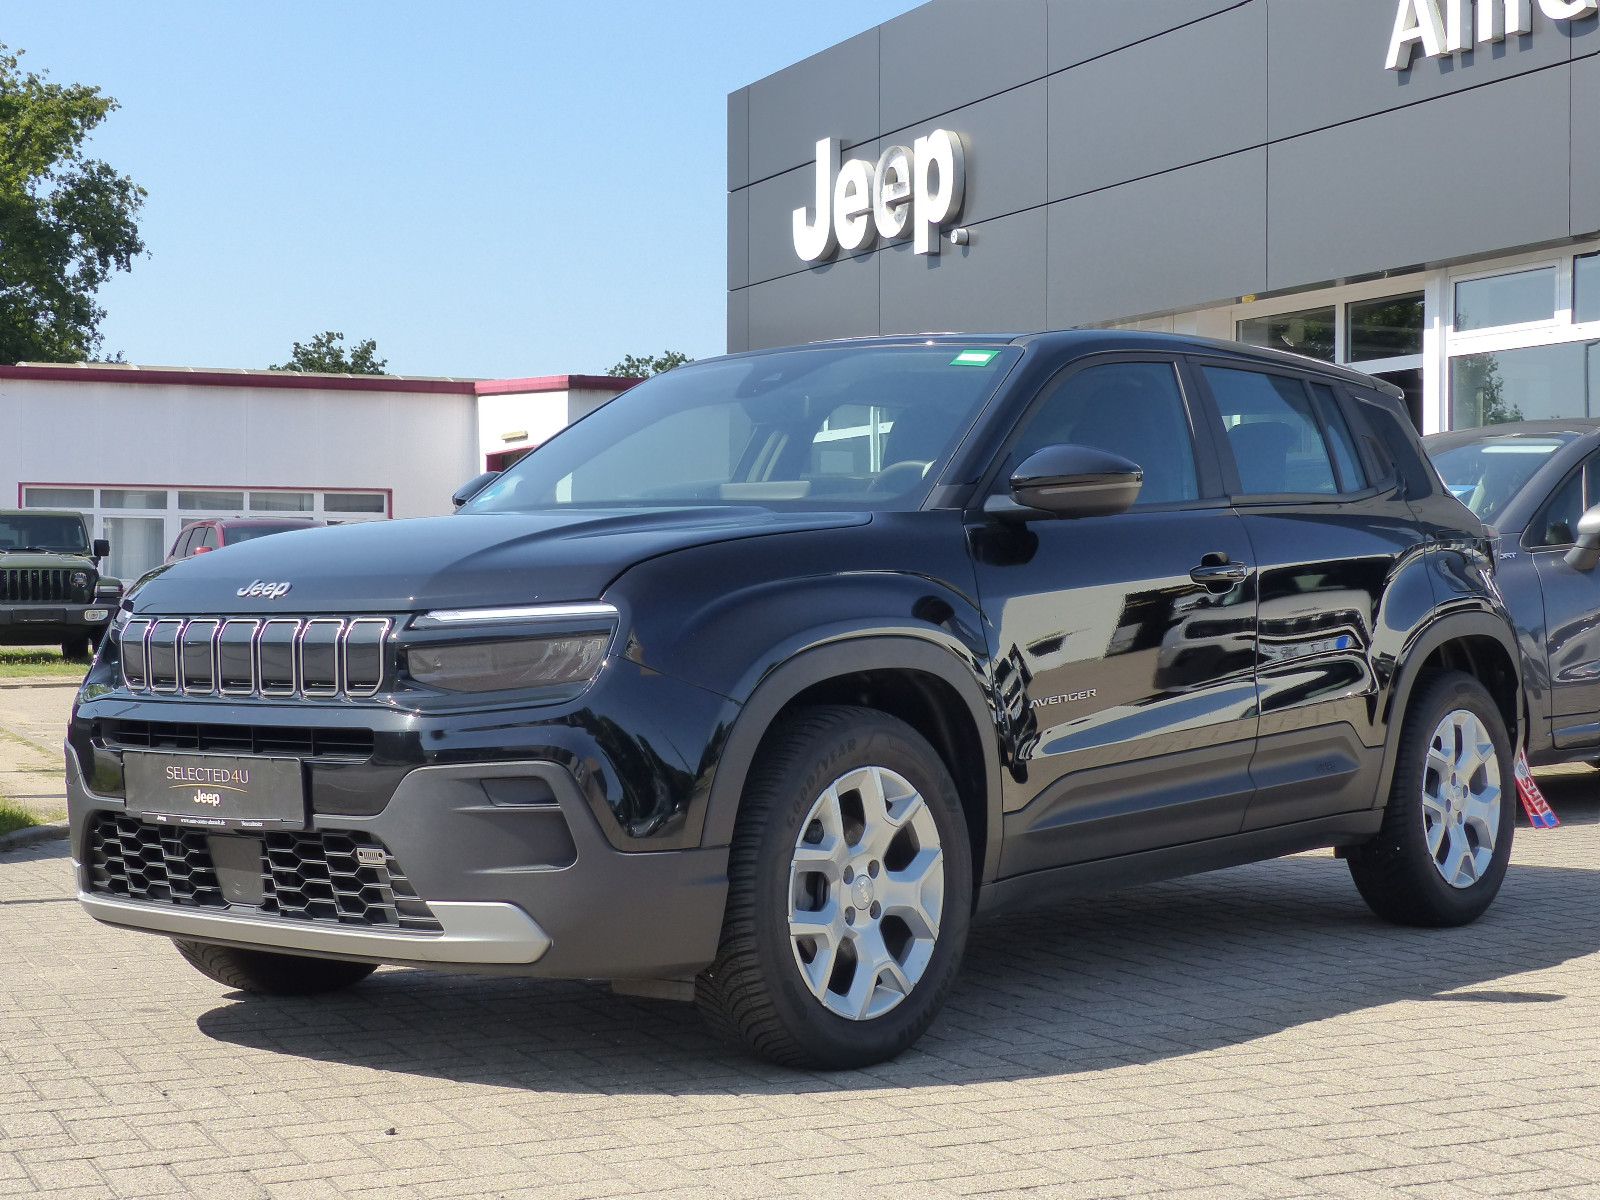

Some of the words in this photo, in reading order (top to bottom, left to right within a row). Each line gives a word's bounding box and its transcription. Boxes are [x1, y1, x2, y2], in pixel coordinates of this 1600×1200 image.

[793, 128, 966, 262] Jeep
[236, 579, 292, 600] Jeep
[1029, 688, 1097, 709] AVENGER
[166, 765, 249, 784] SELECTED4U
[193, 789, 220, 807] Jeep
